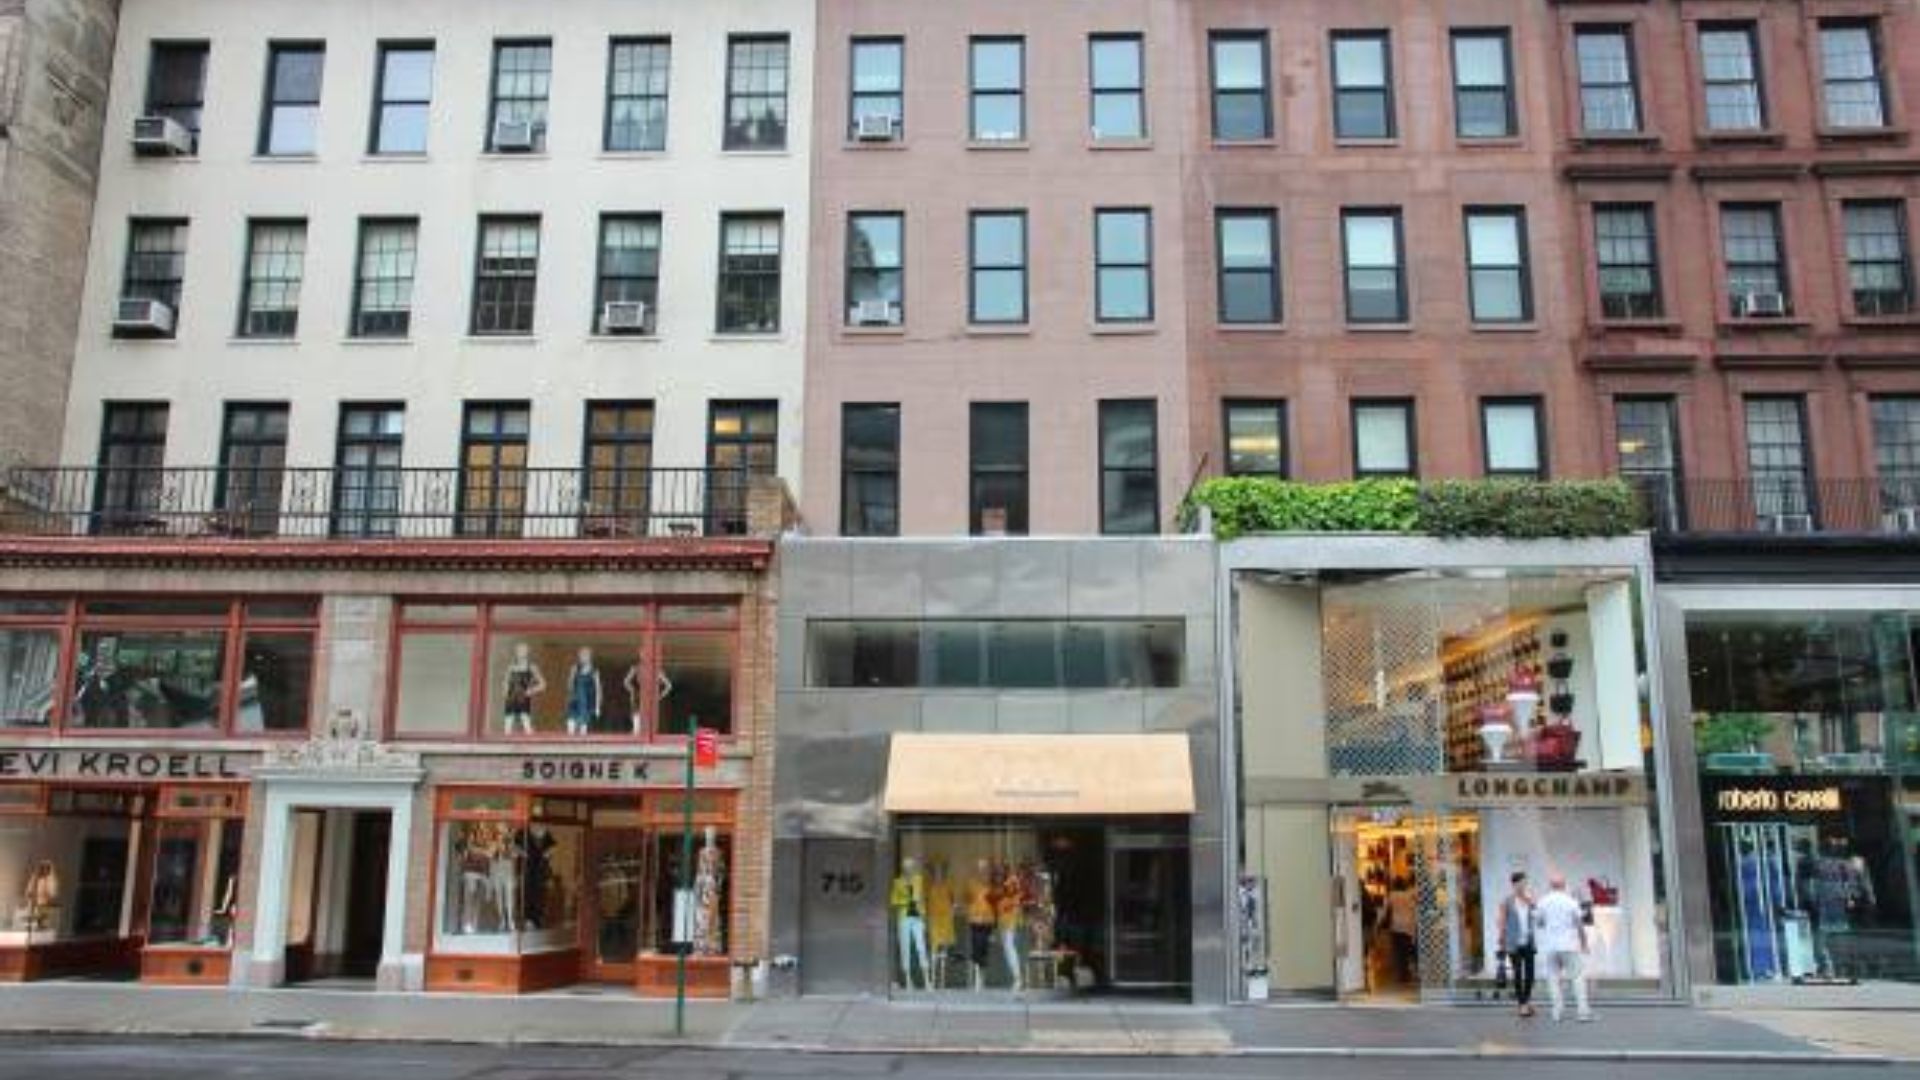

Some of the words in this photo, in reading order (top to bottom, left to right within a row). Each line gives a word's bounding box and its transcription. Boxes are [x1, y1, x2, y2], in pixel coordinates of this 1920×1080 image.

[78, 752, 238, 777] KROELL
[523, 761, 622, 780] SOIGNE
[633, 762, 649, 780] K
[1457, 777, 1631, 797] LONGCHAMP
[1718, 788, 1777, 811] roberto
[1784, 788, 1840, 811] cavalli
[821, 872, 864, 895] 715
